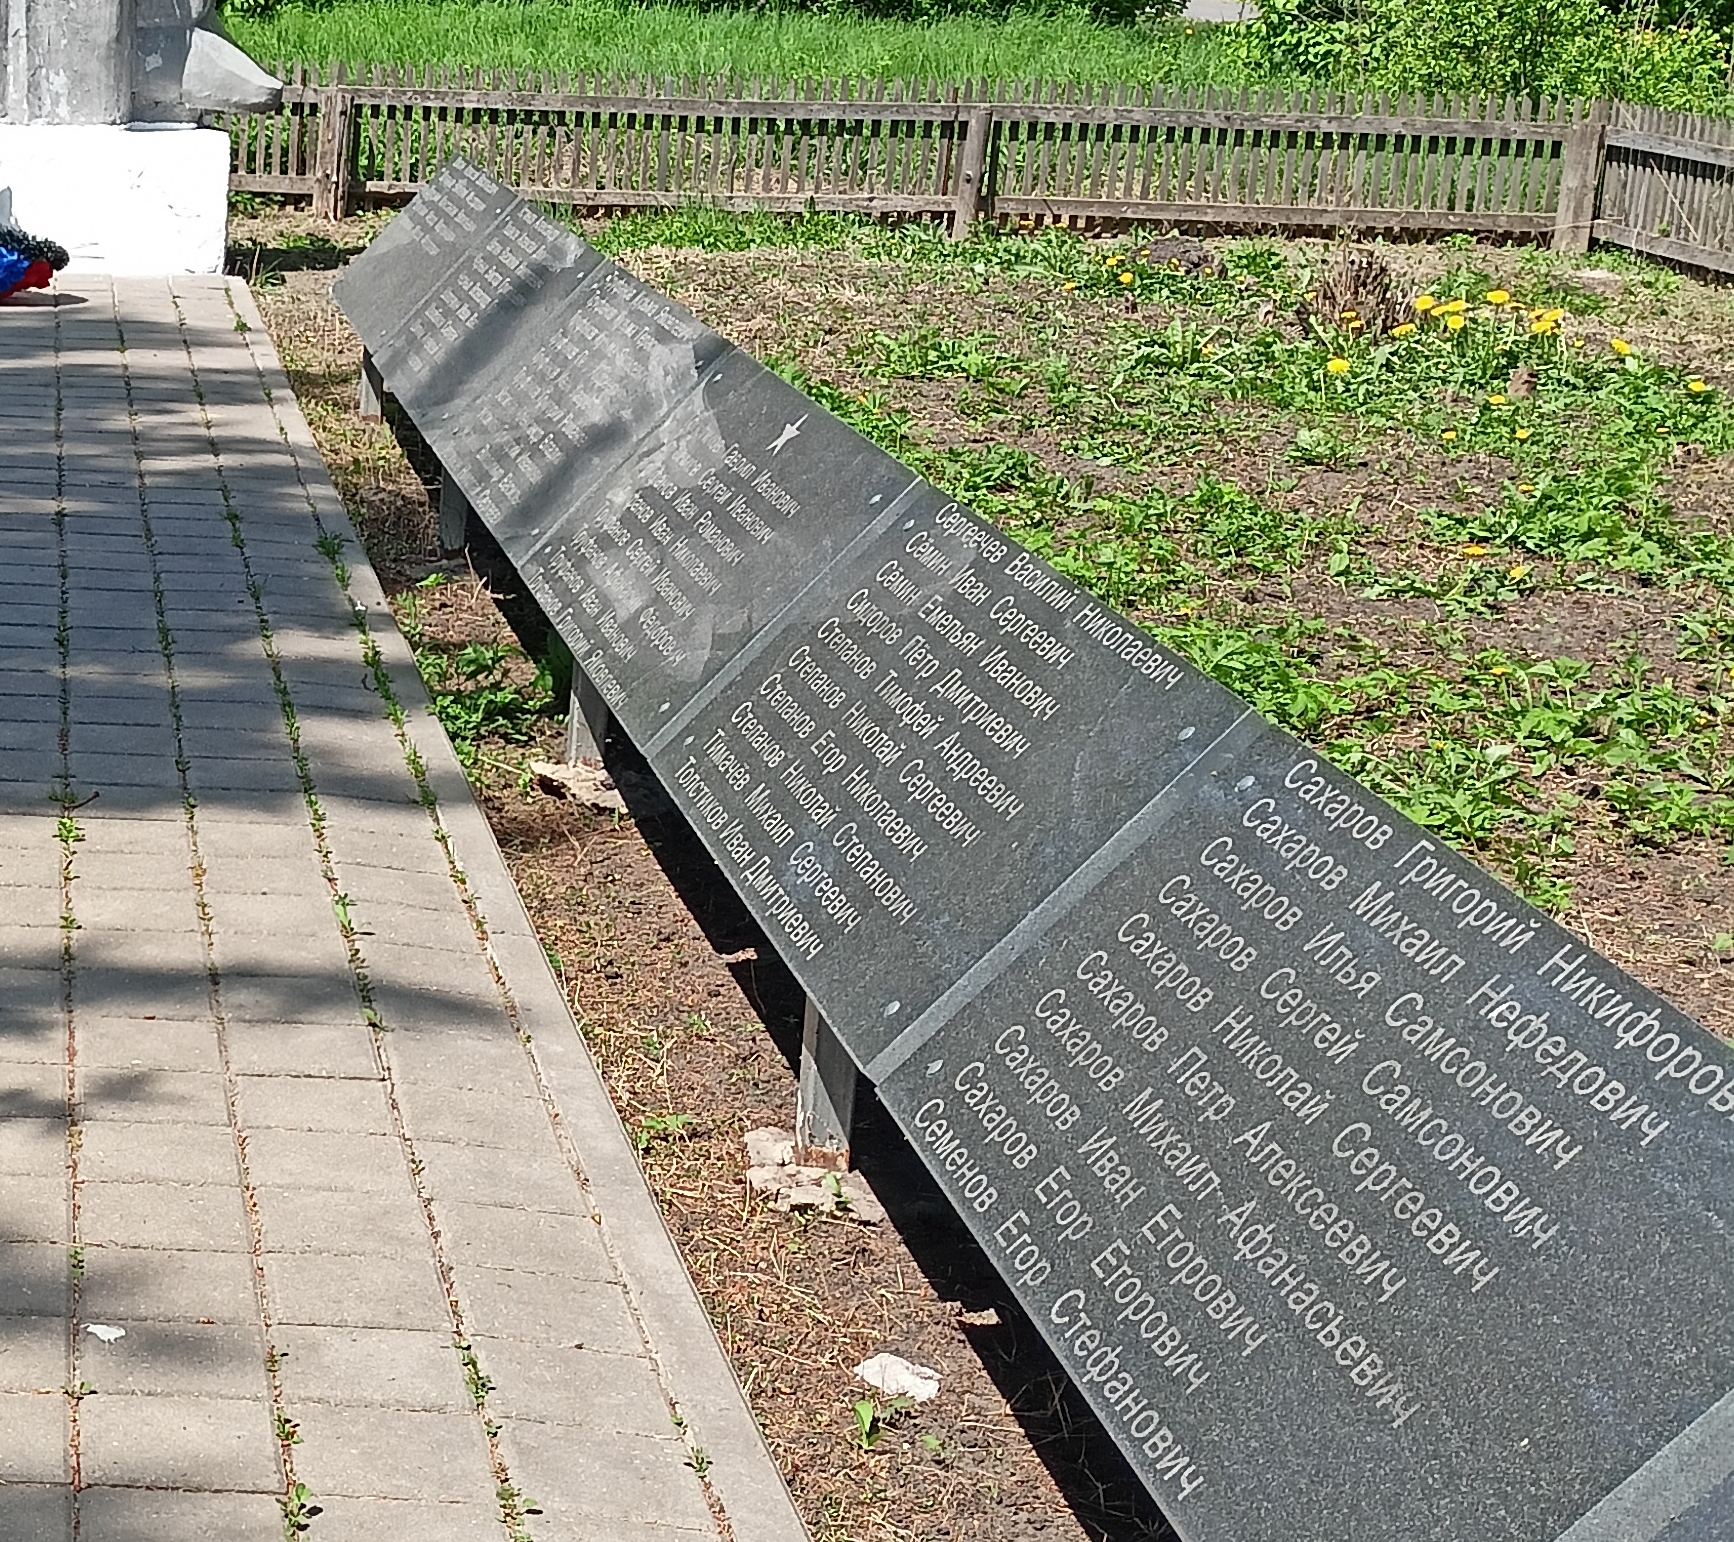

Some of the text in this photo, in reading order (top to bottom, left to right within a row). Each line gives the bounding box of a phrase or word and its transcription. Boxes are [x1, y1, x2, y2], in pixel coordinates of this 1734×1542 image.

[624, 537, 661, 578] Сергей
[649, 567, 694, 623] Иванович
[646, 513, 674, 546] Иван
[667, 535, 721, 598] Николаевич
[670, 489, 699, 522] Иван
[691, 510, 744, 568] Романович
[696, 466, 774, 546] Сергей Иванович
[719, 441, 756, 480] Гаврил
[749, 468, 801, 520] Иванович
[576, 584, 602, 619] Иван
[593, 608, 635, 667] Иванович
[581, 648, 626, 714] Яковлевич
[847, 589, 1030, 759] Сидоров Пётр Дмитриевич
[876, 560, 1060, 720] Сёмин Емельян Иванович
[906, 531, 1075, 670] Сёмин Иван Сергеевич
[936, 503, 1184, 690] Сергеечев Василий Николаевич
[731, 702, 918, 925] Степанов Николай Степанович
[760, 674, 928, 862] Степанов Егор Николаевич
[789, 646, 980, 847] Степанов Николай Сергеевич
[818, 617, 1024, 820] Степанов Тимофей Андреевич
[675, 756, 823, 960] Толстиков Иван Дмитриевич
[703, 728, 861, 933] Тимачёв Михаил Сергеевич
[1201, 837, 1582, 1170] Сахаров Илья Самсонович
[1243, 798, 1669, 1146] Сахаров Михаил Нефедович
[1285, 759, 1734, 1123] Сахаров Григорий Никифоров
[1077, 951, 1406, 1302] Сахаров Петр Алексеевич
[1118, 913, 1499, 1292] Сахаров Николай Сергеевич
[1159, 875, 1558, 1249] Сахаров Сергей Самсонович
[955, 1062, 1209, 1394] Сахаров Егор Егорович
[995, 1025, 1268, 1356] Сахаров Иван Егорович
[1035, 989, 1419, 1427] Сахаров Михаил Афанасьевич
[914, 1099, 1205, 1502] Семенов Егор Стефанович
